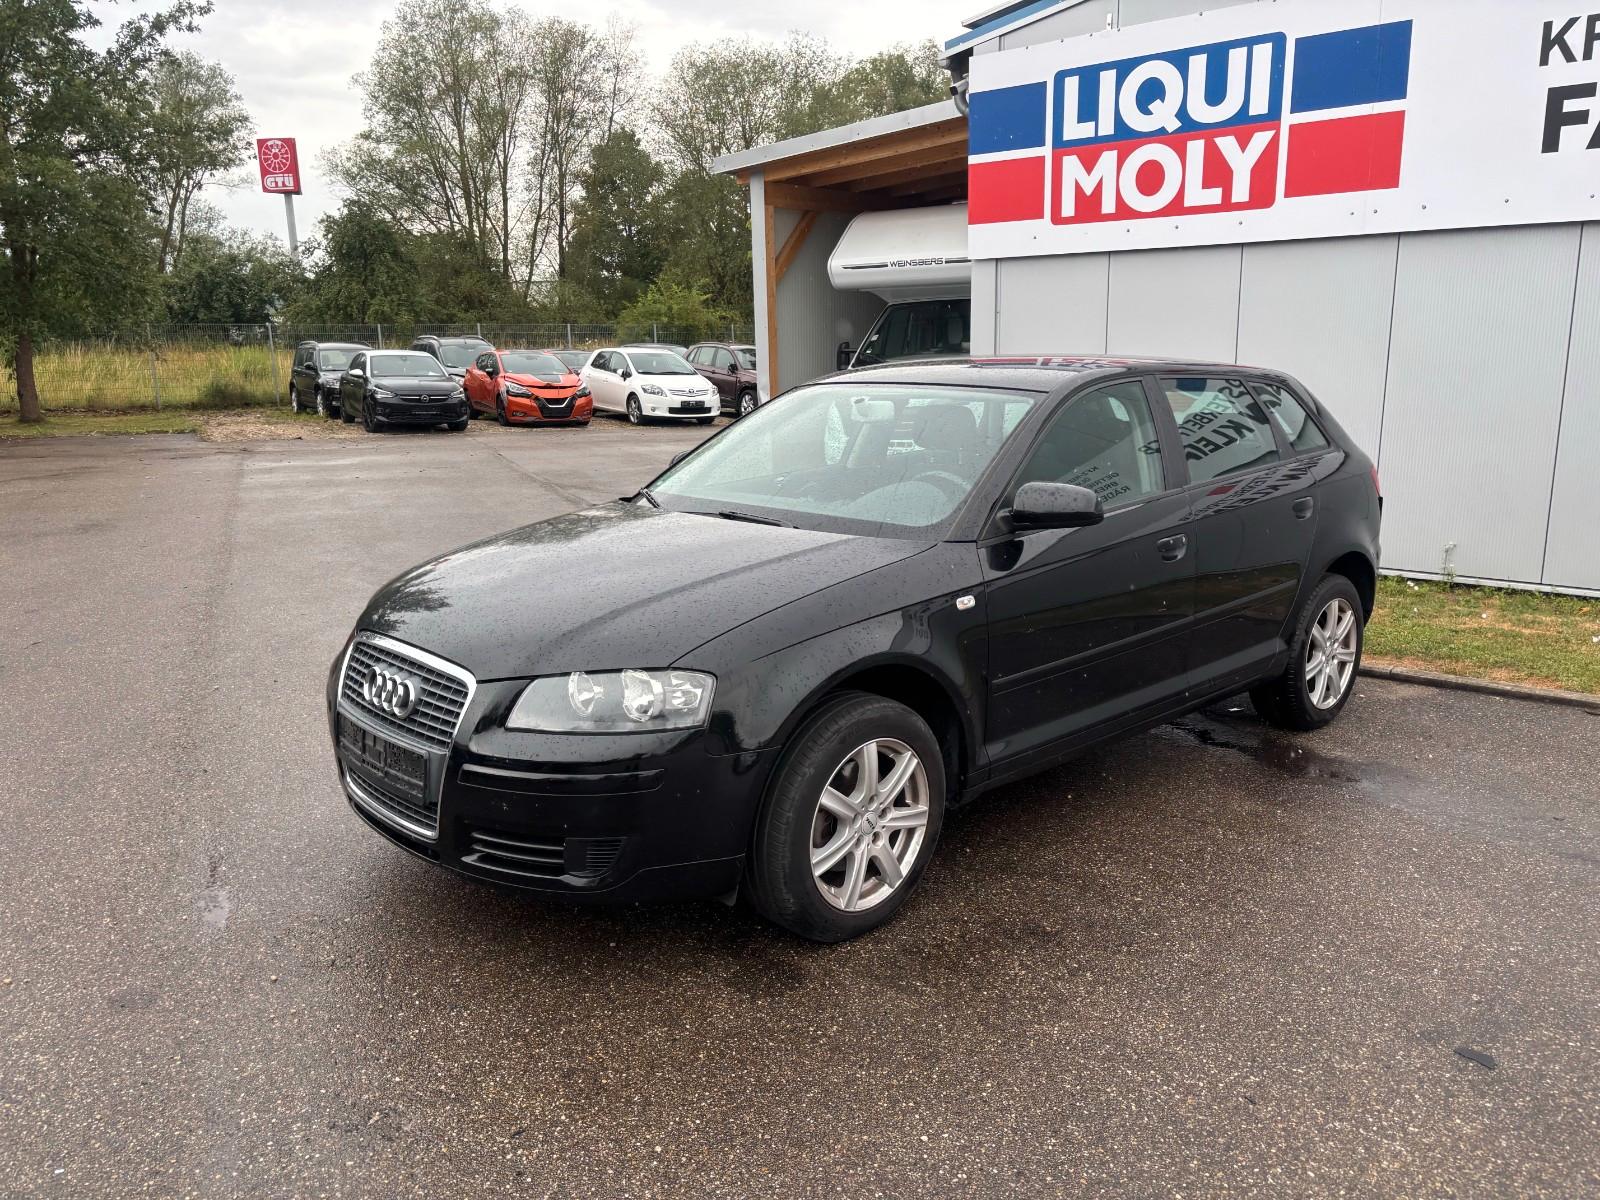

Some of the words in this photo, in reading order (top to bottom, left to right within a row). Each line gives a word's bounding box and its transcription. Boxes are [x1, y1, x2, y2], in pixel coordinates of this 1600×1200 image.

[1062, 42, 1272, 141] LIQUI
[1541, 82, 1600, 154] F
[1061, 130, 1277, 218] MOLY
[889, 257, 944, 268] WEINSBERG
